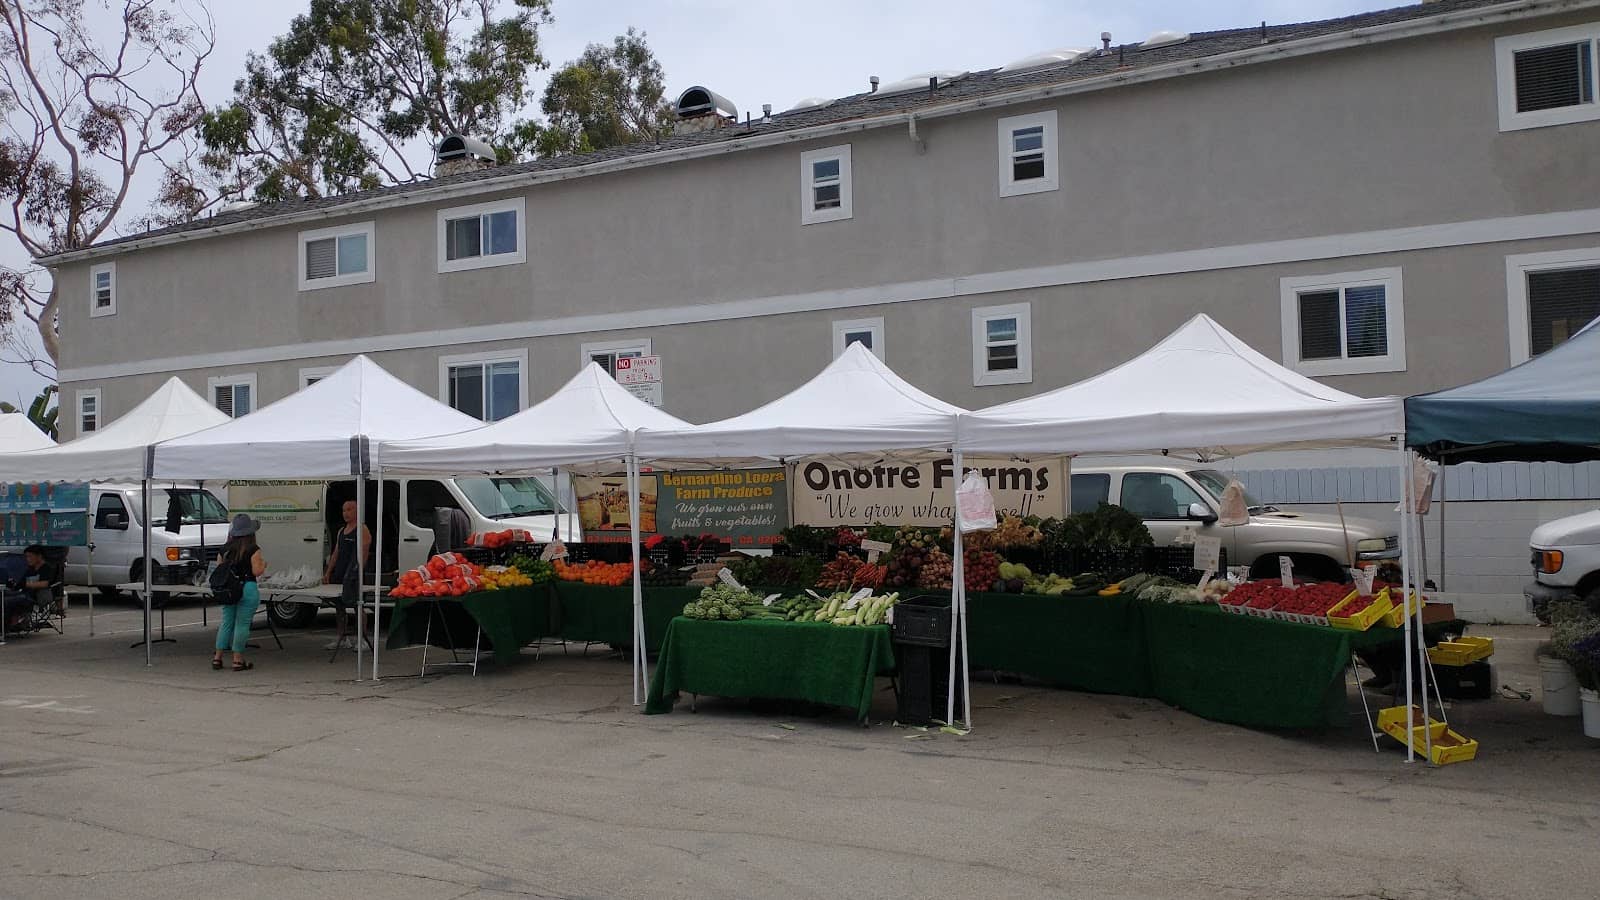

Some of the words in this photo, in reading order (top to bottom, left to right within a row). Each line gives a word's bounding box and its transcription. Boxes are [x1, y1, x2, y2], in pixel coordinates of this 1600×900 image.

[618, 359, 630, 369] NO
[633, 358, 656, 367] PARKING
[664, 473, 742, 486] Bernardino
[745, 471, 785, 484] Loera
[676, 487, 711, 499] Farm
[713, 486, 773, 499] Produce
[675, 502, 697, 513] We
[697, 503, 723, 518] grow
[727, 503, 747, 513] our
[750, 502, 773, 511] own
[864, 502, 904, 525] grow
[912, 491, 956, 518] wha
[671, 516, 701, 530] fruits
[704, 517, 713, 527] &
[715, 514, 777, 531] vegetables!
